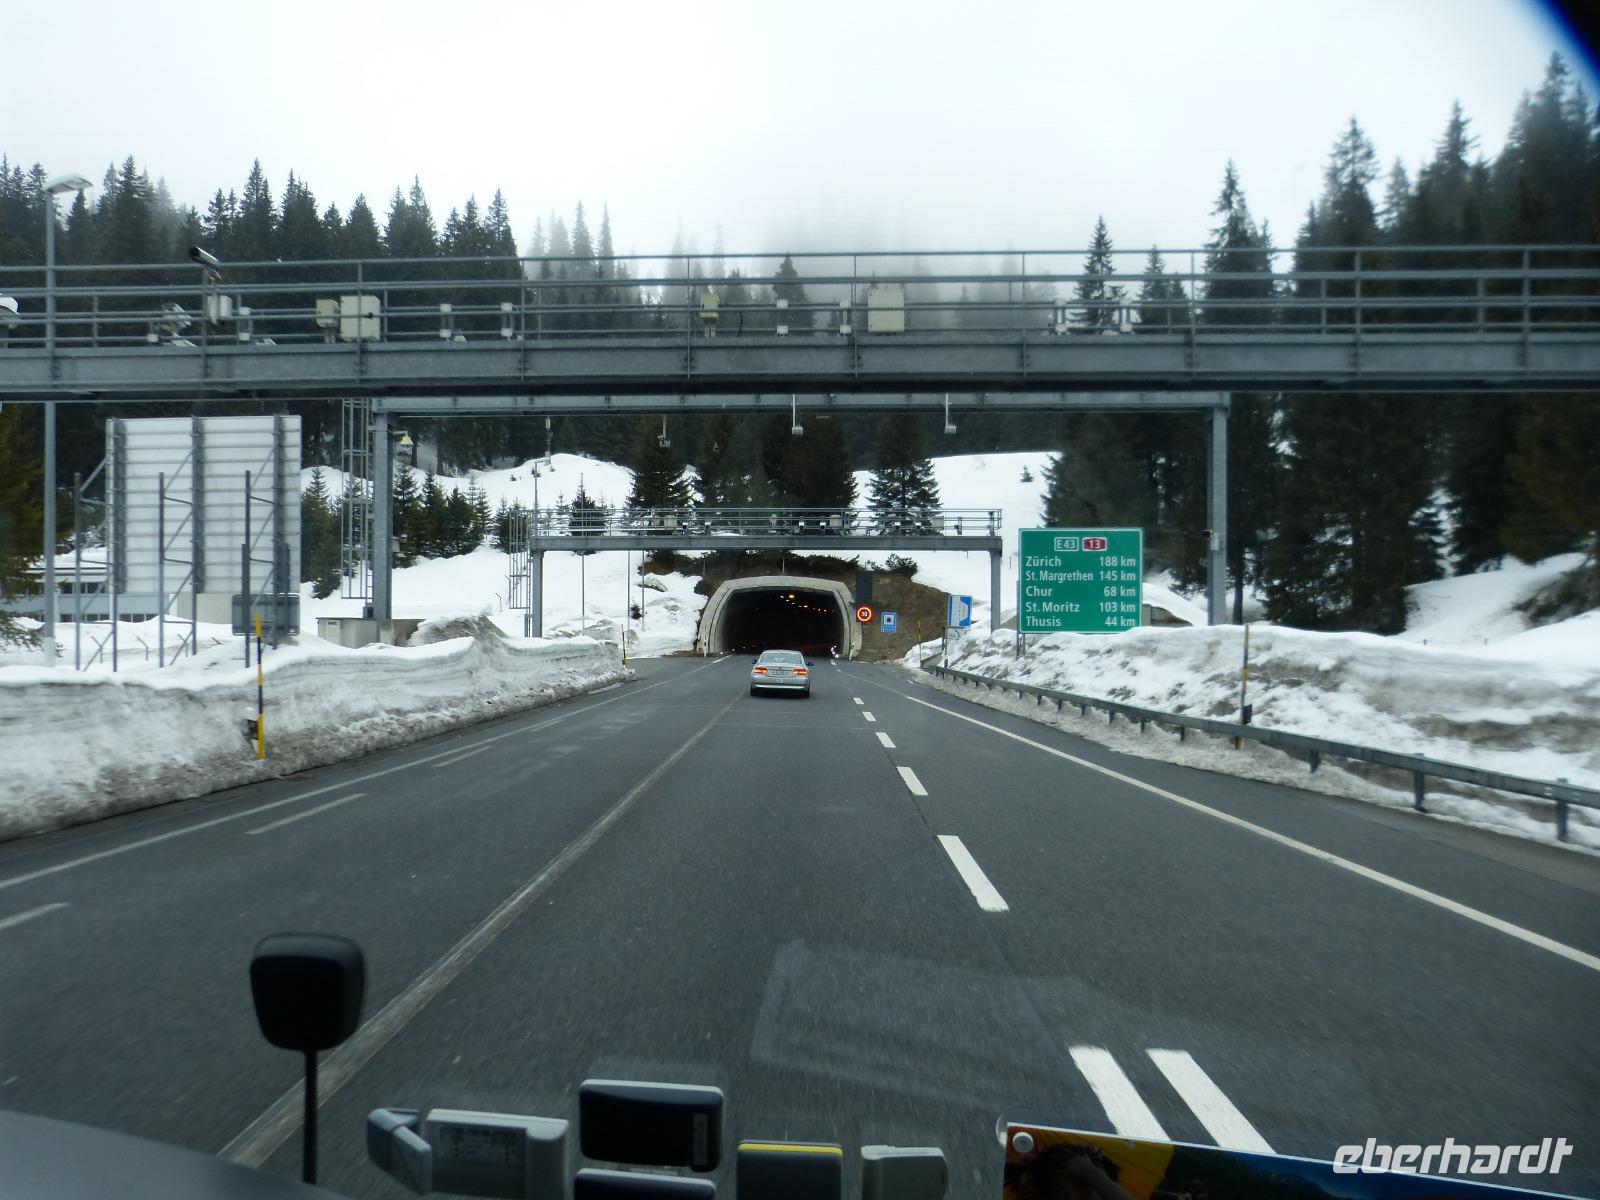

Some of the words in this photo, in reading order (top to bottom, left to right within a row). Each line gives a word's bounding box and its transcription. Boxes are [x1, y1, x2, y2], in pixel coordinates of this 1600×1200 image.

[1088, 540, 1101, 549] 13
[1025, 556, 1062, 567] Zürich
[1099, 556, 1117, 567] 188
[1120, 556, 1136, 567] km
[1025, 571, 1038, 581] St.
[1039, 571, 1094, 584] Margrethen
[1099, 571, 1117, 581] 145
[1120, 571, 1136, 581] km
[1025, 586, 1053, 597] Chur
[1103, 586, 1117, 597] 68
[1120, 586, 1136, 597] km
[1025, 602, 1040, 612] St.
[1042, 602, 1080, 612] Moritz
[1099, 602, 1117, 612] 103
[1120, 602, 1136, 612] km
[1025, 616, 1062, 627] Thusis
[1104, 616, 1117, 627] 44
[1120, 616, 1136, 627] km
